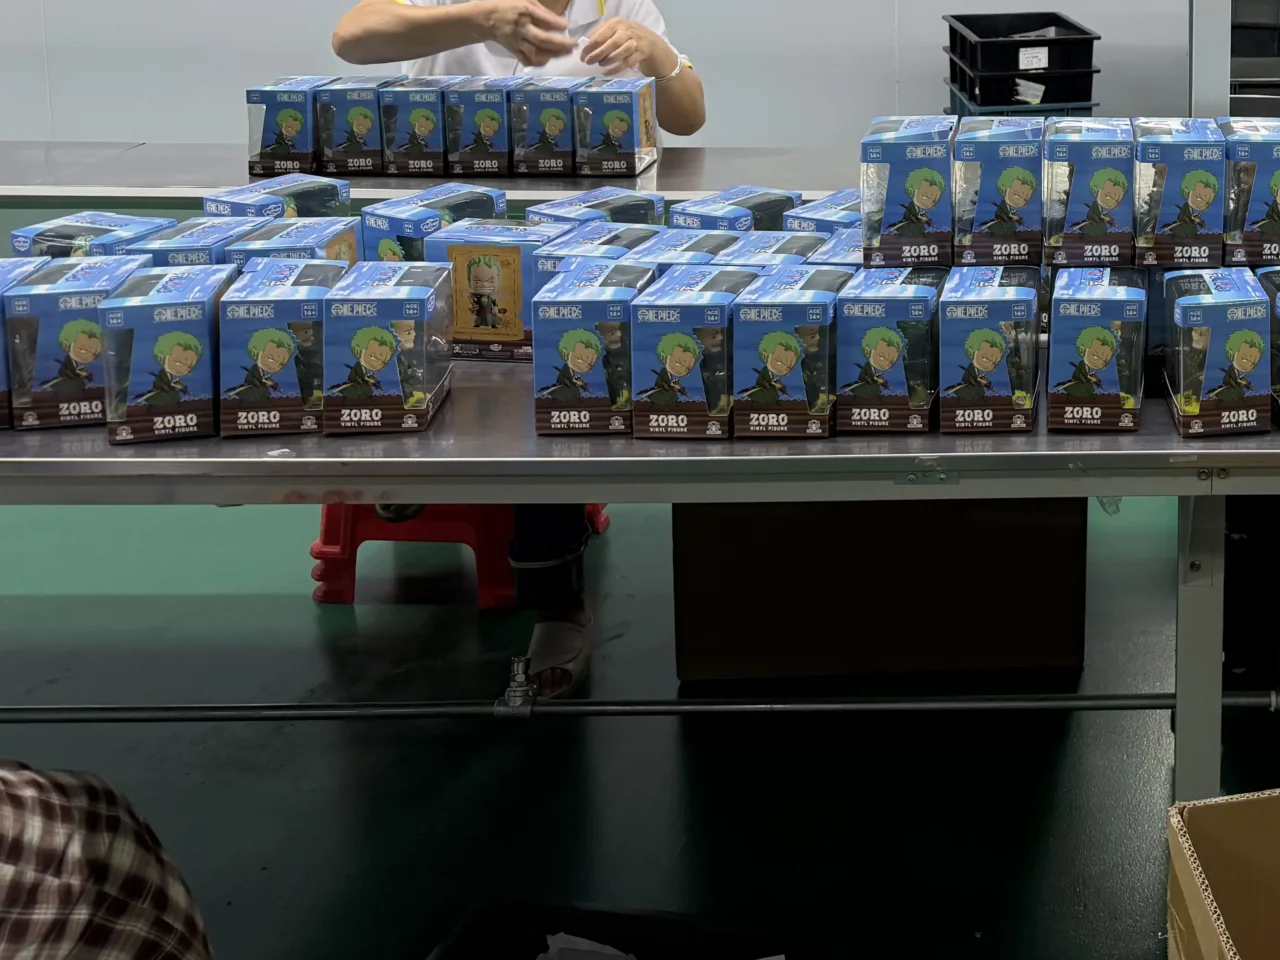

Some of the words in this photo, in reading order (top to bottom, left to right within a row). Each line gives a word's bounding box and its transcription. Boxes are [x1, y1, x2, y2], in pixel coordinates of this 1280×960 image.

[275, 161, 299, 169] ZORO
[902, 245, 938, 257] ZORO
[993, 244, 1028, 255] ZORO
[1084, 245, 1119, 256] ZORO
[1174, 247, 1209, 257] ZORO
[59, 401, 102, 415] ZORO
[1064, 407, 1101, 418] ZORO
[238, 411, 280, 423] ZORO
[341, 409, 381, 421] ZORO
[551, 411, 589, 423] ZORO
[750, 414, 787, 425] ZORO
[852, 409, 889, 420] ZORO
[955, 410, 993, 421] ZORO
[1221, 410, 1257, 423] ZORO
[154, 414, 197, 428] ZORO
[650, 415, 687, 426] ZORO
